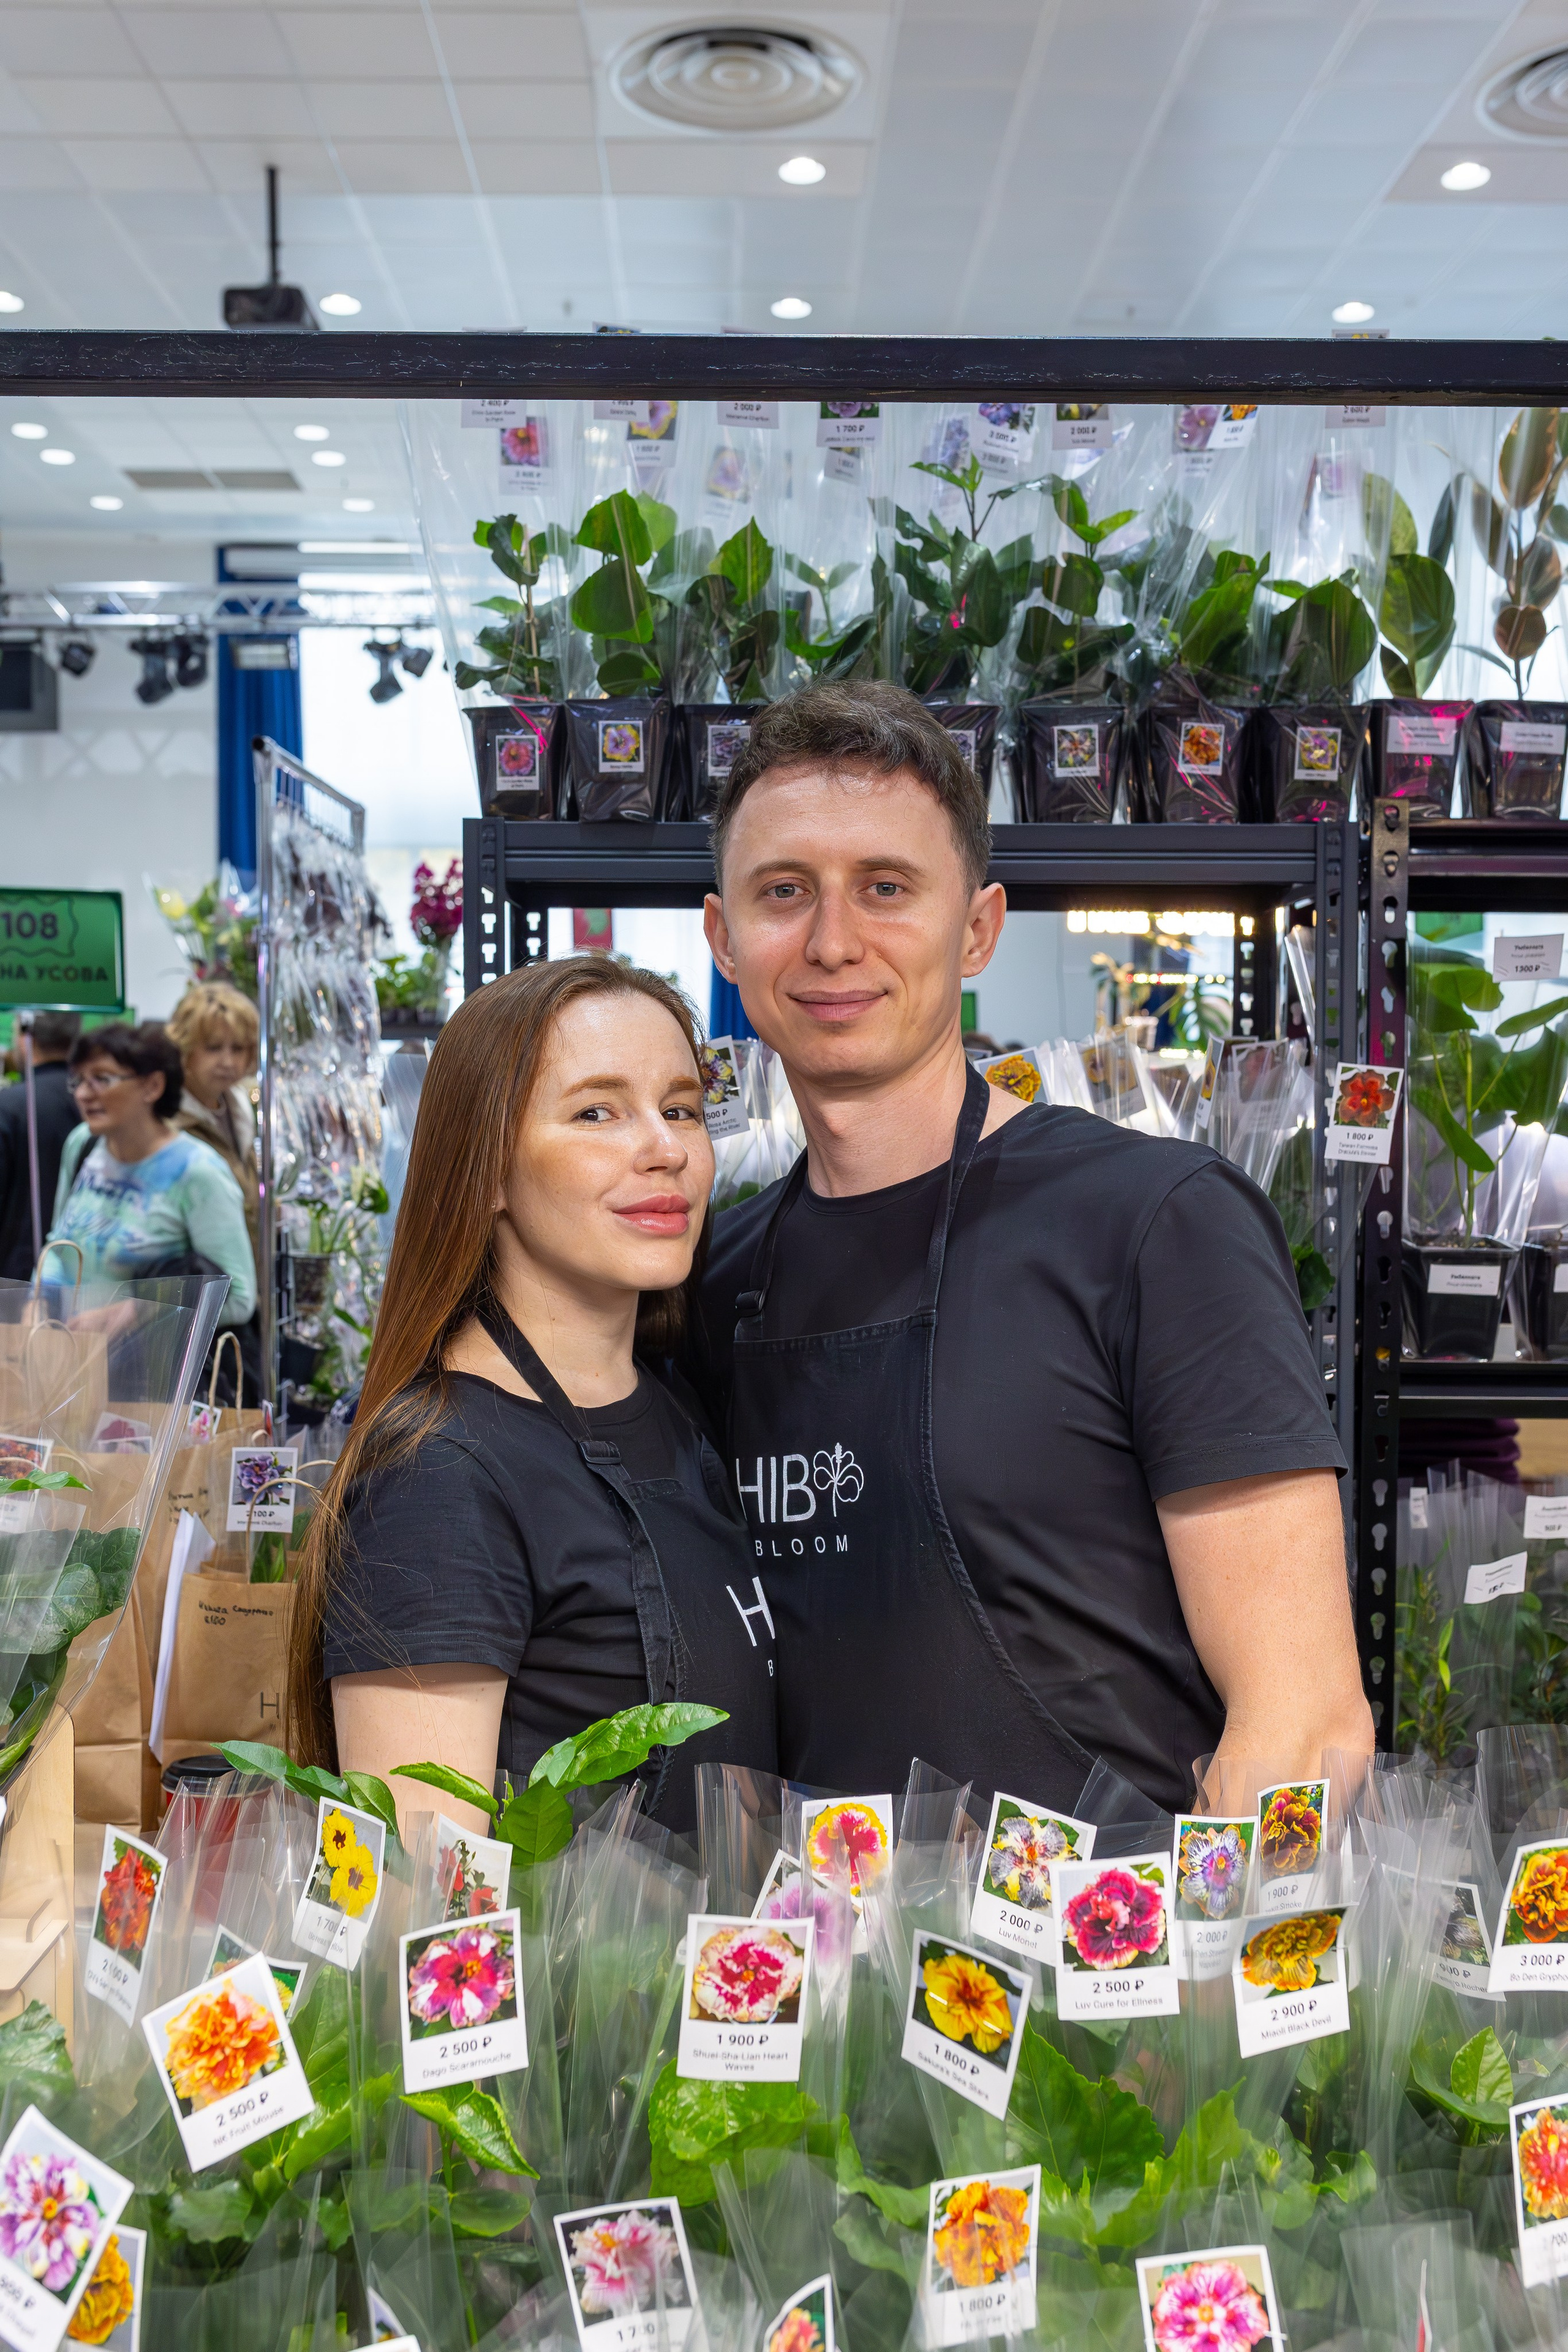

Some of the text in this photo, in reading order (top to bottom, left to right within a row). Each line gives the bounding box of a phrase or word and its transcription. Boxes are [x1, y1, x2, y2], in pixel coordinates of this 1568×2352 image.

[34, 964, 109, 982] УСОВА
[706, 1110, 720, 1120] 500
[755, 1534, 848, 1556] BLOOM
[725, 1575, 776, 1647] H
[1272, 1885, 1289, 1899] 900
[1000, 1910, 1044, 1935] 2 000 ₽
[998, 1926, 1038, 1950] Luv Monet
[1196, 1931, 1204, 1943] 2
[1205, 1931, 1221, 1943] 000
[1531, 1954, 1553, 1966] 000
[1556, 1954, 1566, 1966] ₽
[1093, 1979, 1144, 1994] 2 500 ₽
[1075, 2000, 1091, 2010] Luv
[1093, 1999, 1115, 2010] Cure
[1116, 1999, 1129, 2008] for
[1271, 1999, 1317, 2022] 2 900 ₽
[1287, 2021, 1311, 2034] Black
[1311, 2015, 1332, 2028] Devil
[440, 2035, 492, 2059] 2 500 ₽
[717, 2034, 769, 2046] 1 900 ₽
[935, 2042, 980, 2076] 1 800 ₽
[216, 2090, 270, 2128] 2 500 ₽
